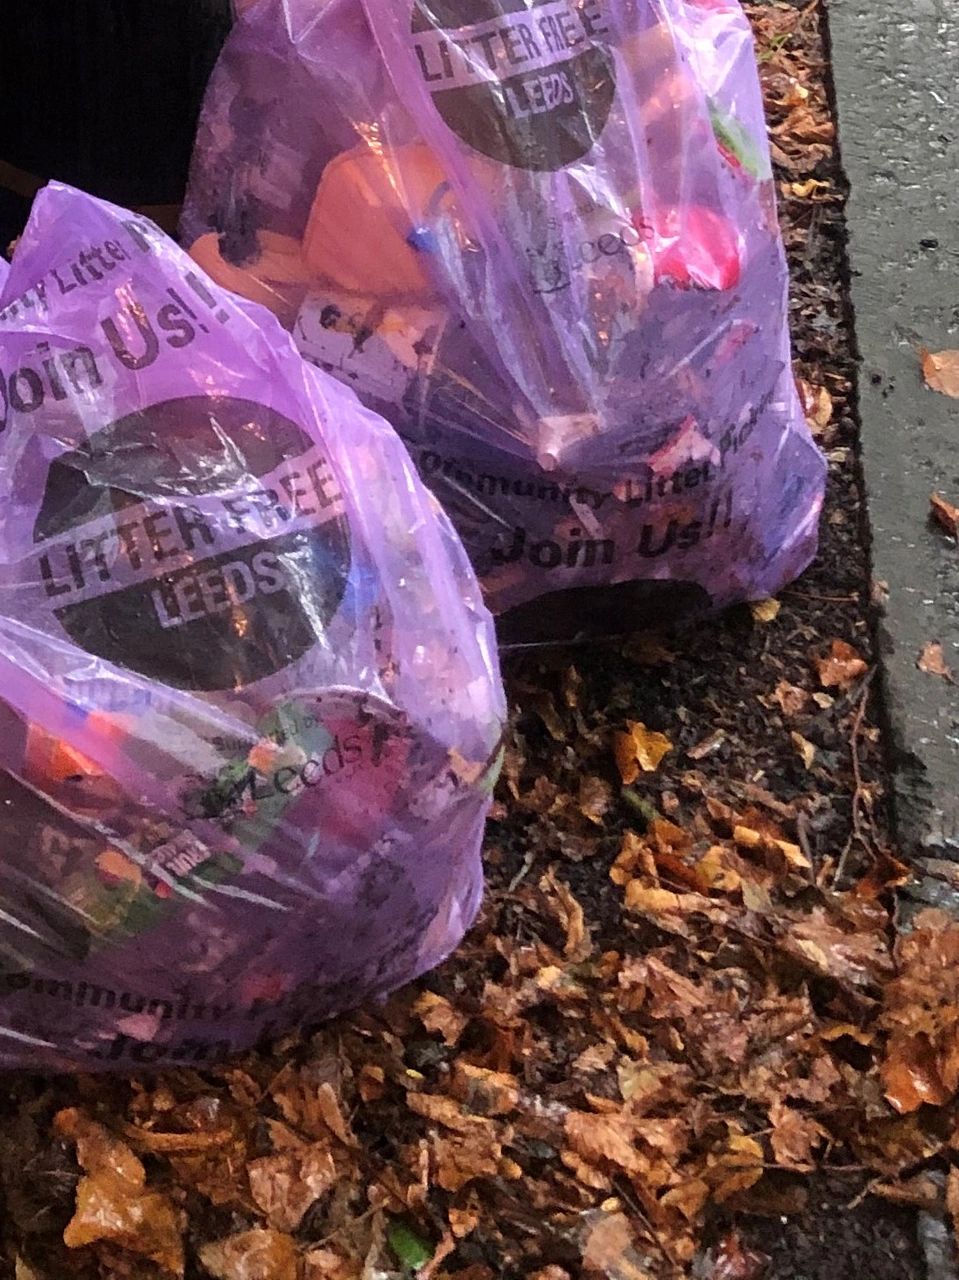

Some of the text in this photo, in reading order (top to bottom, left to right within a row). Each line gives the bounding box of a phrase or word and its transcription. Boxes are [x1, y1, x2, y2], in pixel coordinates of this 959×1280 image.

[414, 23, 542, 82] LITTER
[504, 70, 574, 119] LEEDS
[50, 238, 132, 296] Litter
[100, 271, 231, 370] Us!!
[422, 449, 612, 509] ommunity
[625, 457, 717, 508] Litter
[40, 456, 344, 598] LITTER FREE
[492, 526, 616, 570] Join
[153, 550, 288, 629] LEEDS
